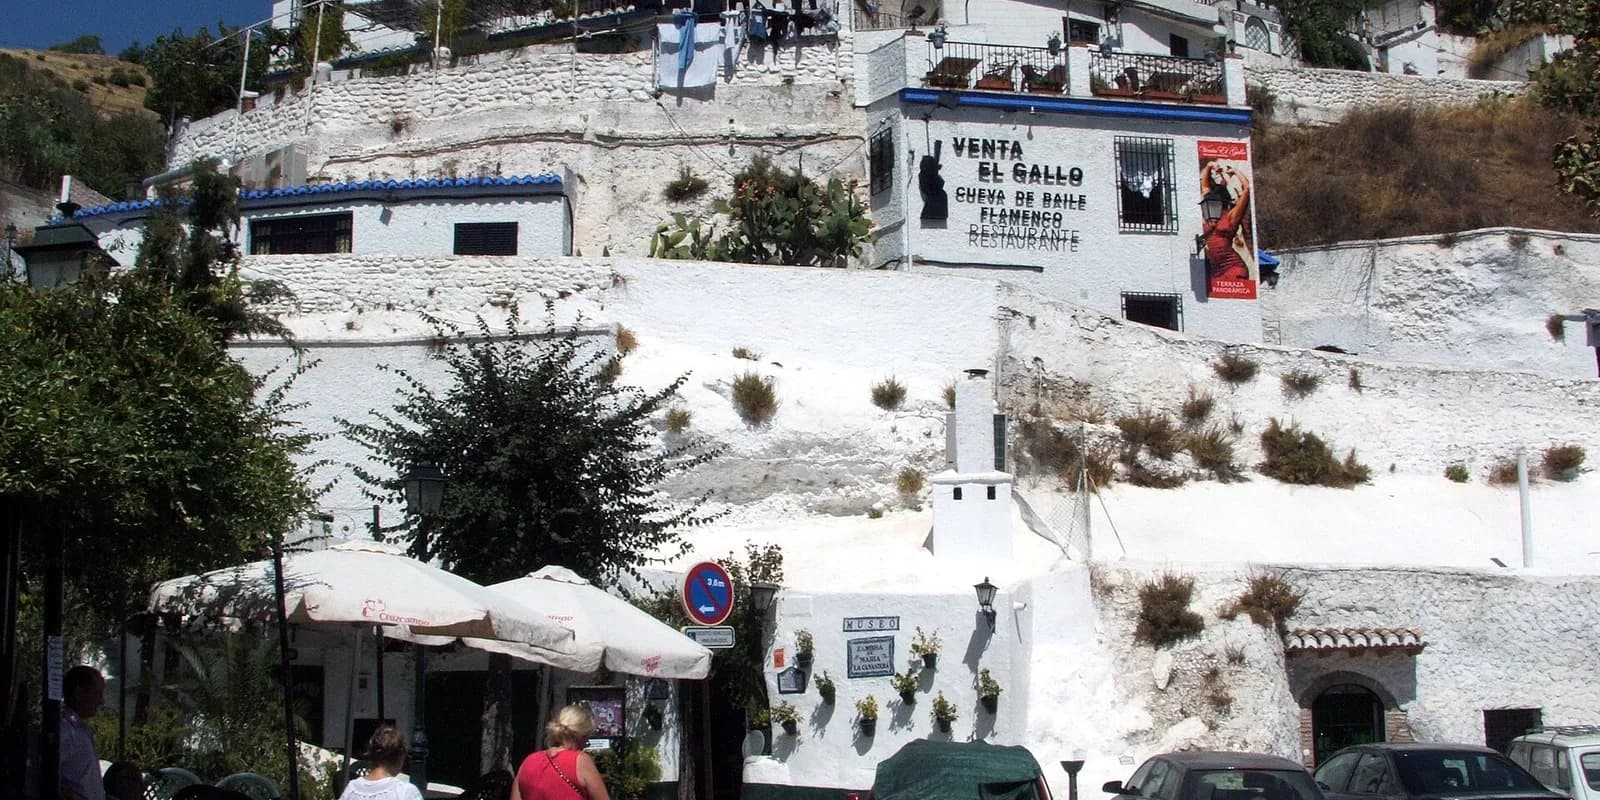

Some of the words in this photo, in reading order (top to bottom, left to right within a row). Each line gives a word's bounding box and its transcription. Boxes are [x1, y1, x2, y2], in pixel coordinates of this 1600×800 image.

[952, 136, 1024, 157] VENTA
[978, 161, 1004, 180] EL
[1012, 163, 1083, 184] GALLO
[956, 186, 1006, 202] CUEVA
[1015, 190, 1035, 204] DE
[1043, 192, 1087, 208] BAILE
[980, 206, 1063, 225] FLAMENCO
[968, 223, 1080, 244] RESTAURANTE
[379, 612, 430, 625] Cruzcampo
[846, 620, 896, 629] MUSEO
